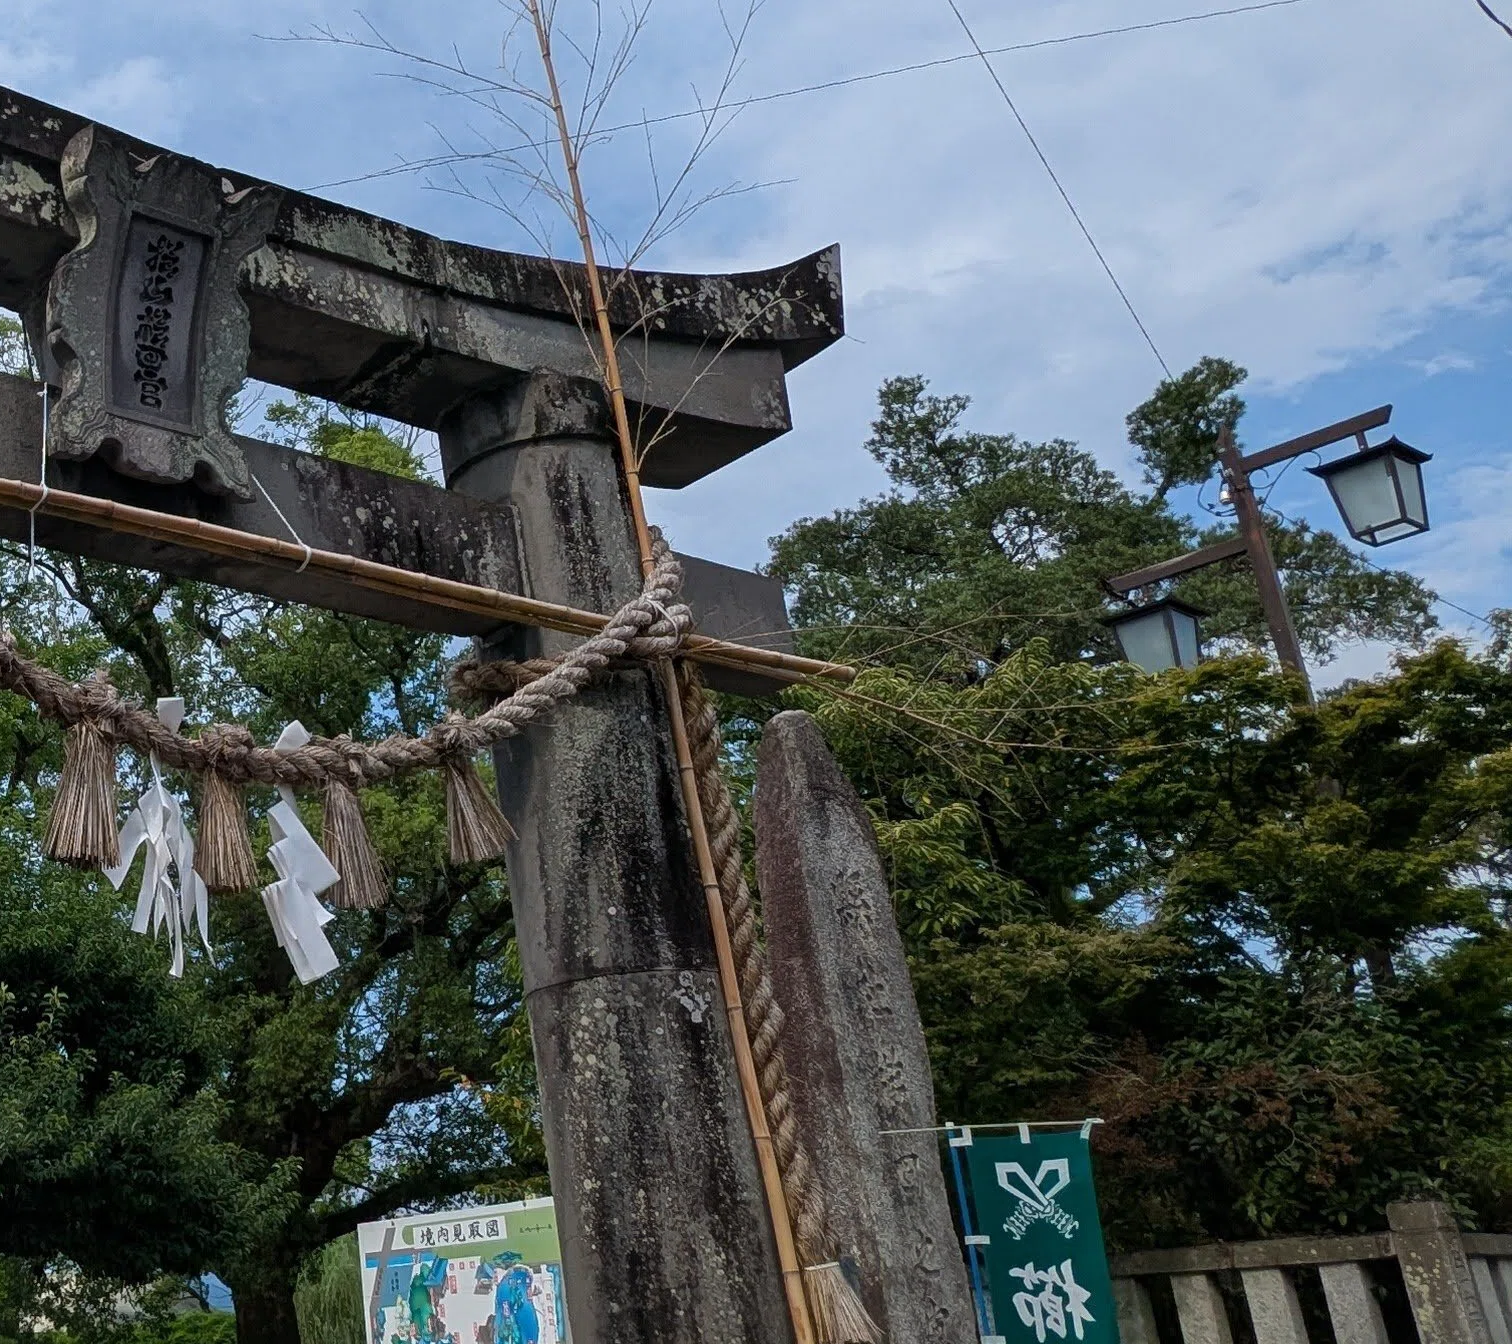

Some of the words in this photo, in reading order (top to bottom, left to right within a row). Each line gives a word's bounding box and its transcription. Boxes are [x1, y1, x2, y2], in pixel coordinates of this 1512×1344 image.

[419, 1219, 500, 1247] 境内見取図
